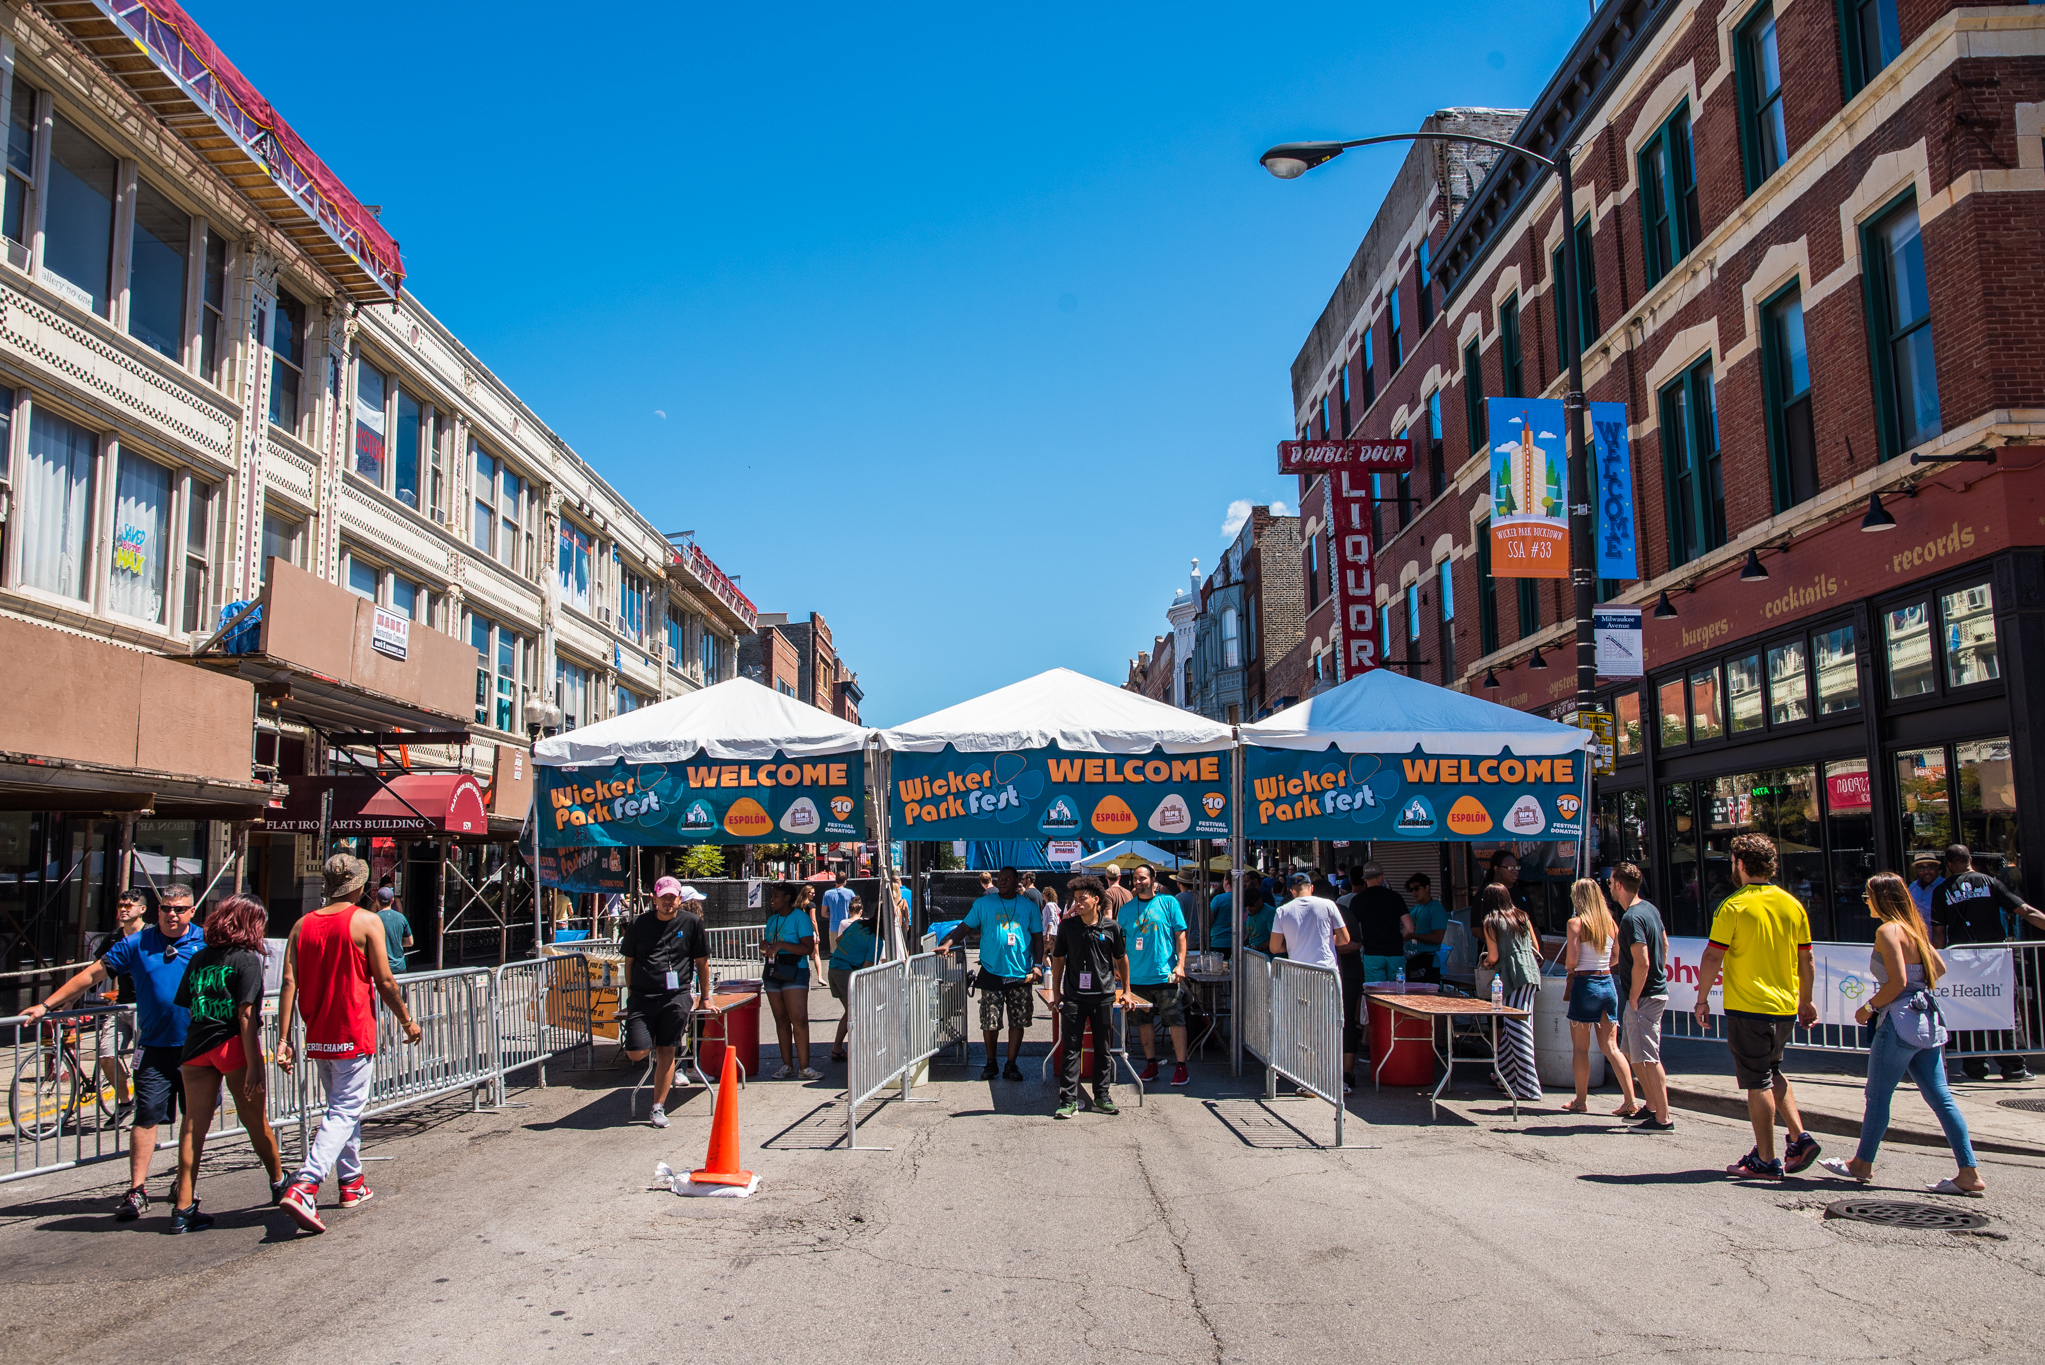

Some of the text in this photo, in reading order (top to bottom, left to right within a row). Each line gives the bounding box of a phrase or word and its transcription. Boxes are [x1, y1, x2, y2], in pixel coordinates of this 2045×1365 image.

[42, 271, 92, 306] allery no one
[1290, 445, 1407, 464] DOUBLE DOOR
[1595, 420, 1630, 560] WELCOME
[121, 523, 146, 546] SAVED
[1496, 527, 1563, 541] WICKER PARK BUCKTOWN
[1508, 540, 1552, 558] SSA #33
[1892, 521, 1975, 573] records
[116, 546, 146, 575] MAX
[1341, 470, 1375, 679] LIQUOR
[1765, 573, 1838, 618] cocktails
[1682, 618, 1729, 649] burgers
[1549, 674, 1578, 699] oysters
[686, 763, 848, 788] WELCOME
[1047, 757, 1220, 782] WELCOME
[1402, 759, 1574, 783] WELCOME
[550, 777, 635, 809] Wicker
[898, 770, 992, 803] Wicker
[1253, 770, 1347, 801] Wicker
[830, 801, 852, 812] $10
[904, 795, 966, 826] Park
[1201, 797, 1224, 809] $10
[1258, 794, 1322, 825] Park
[1556, 799, 1579, 811] $10
[266, 819, 425, 830] FLAT IRO ARTS BUILDING
[555, 802, 613, 830] Park
[1952, 983, 2001, 997] Health
[323, 1042, 354, 1053] CHAMPS
